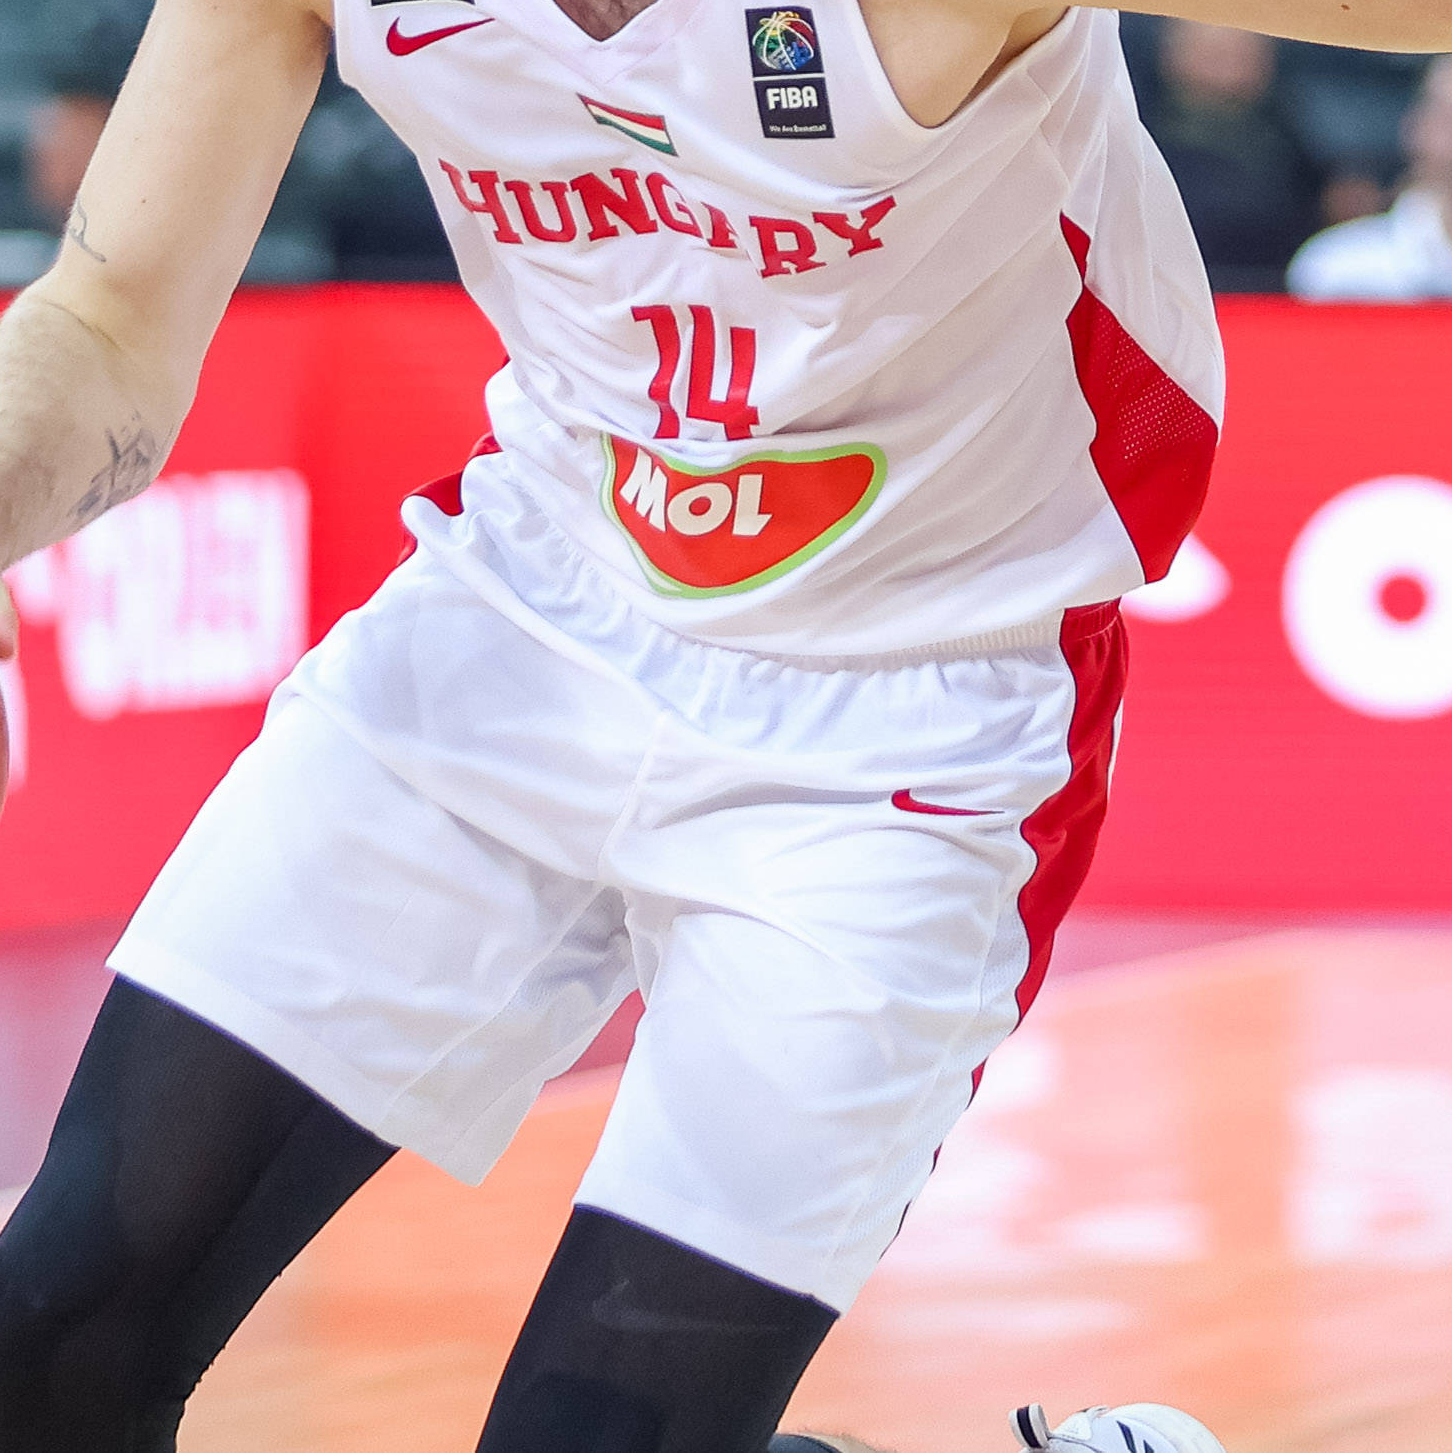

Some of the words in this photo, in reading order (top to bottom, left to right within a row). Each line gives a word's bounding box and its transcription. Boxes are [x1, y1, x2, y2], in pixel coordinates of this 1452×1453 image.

[766, 85, 819, 111] FIBA
[438, 158, 897, 279] HUNGARY
[631, 304, 760, 442] 14
[619, 447, 773, 536] MOL
